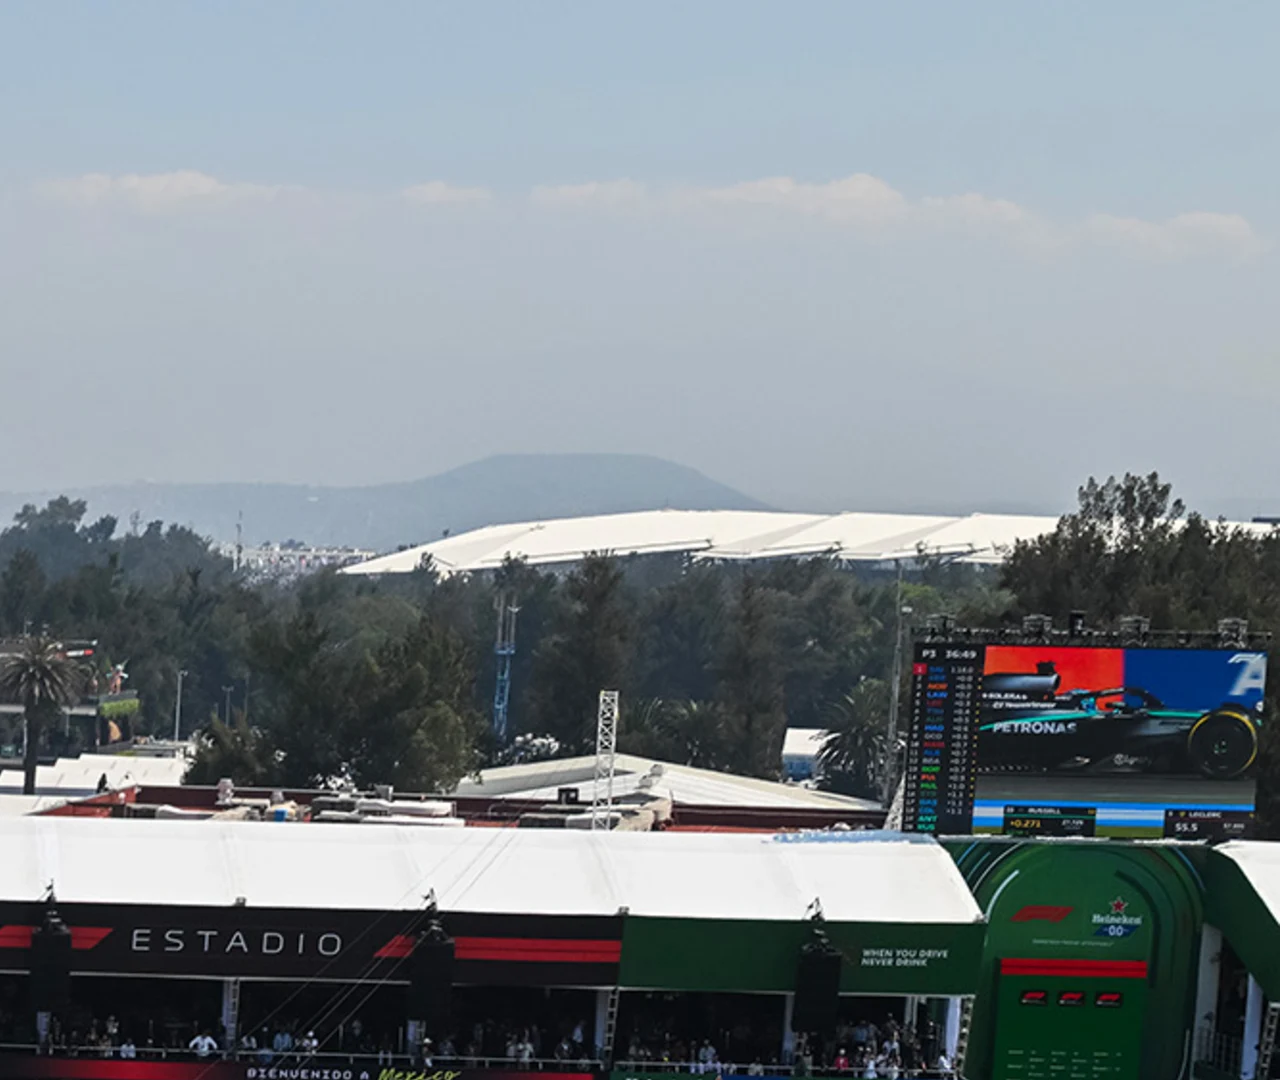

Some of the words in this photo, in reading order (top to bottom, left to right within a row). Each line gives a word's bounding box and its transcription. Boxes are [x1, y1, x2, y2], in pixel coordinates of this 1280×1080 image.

[993, 722, 1077, 734] PETRONAS
[1091, 914, 1142, 925] Heineken
[131, 928, 342, 956] ESTADIO
[862, 949, 893, 958] WHEN
[895, 949, 915, 959] YOU
[918, 950, 949, 960] DRIVE
[861, 957, 893, 967] NEVER
[895, 958, 928, 968] DRINK
[247, 1068, 352, 1080] BIENVENIDO
[360, 1071, 370, 1080] A
